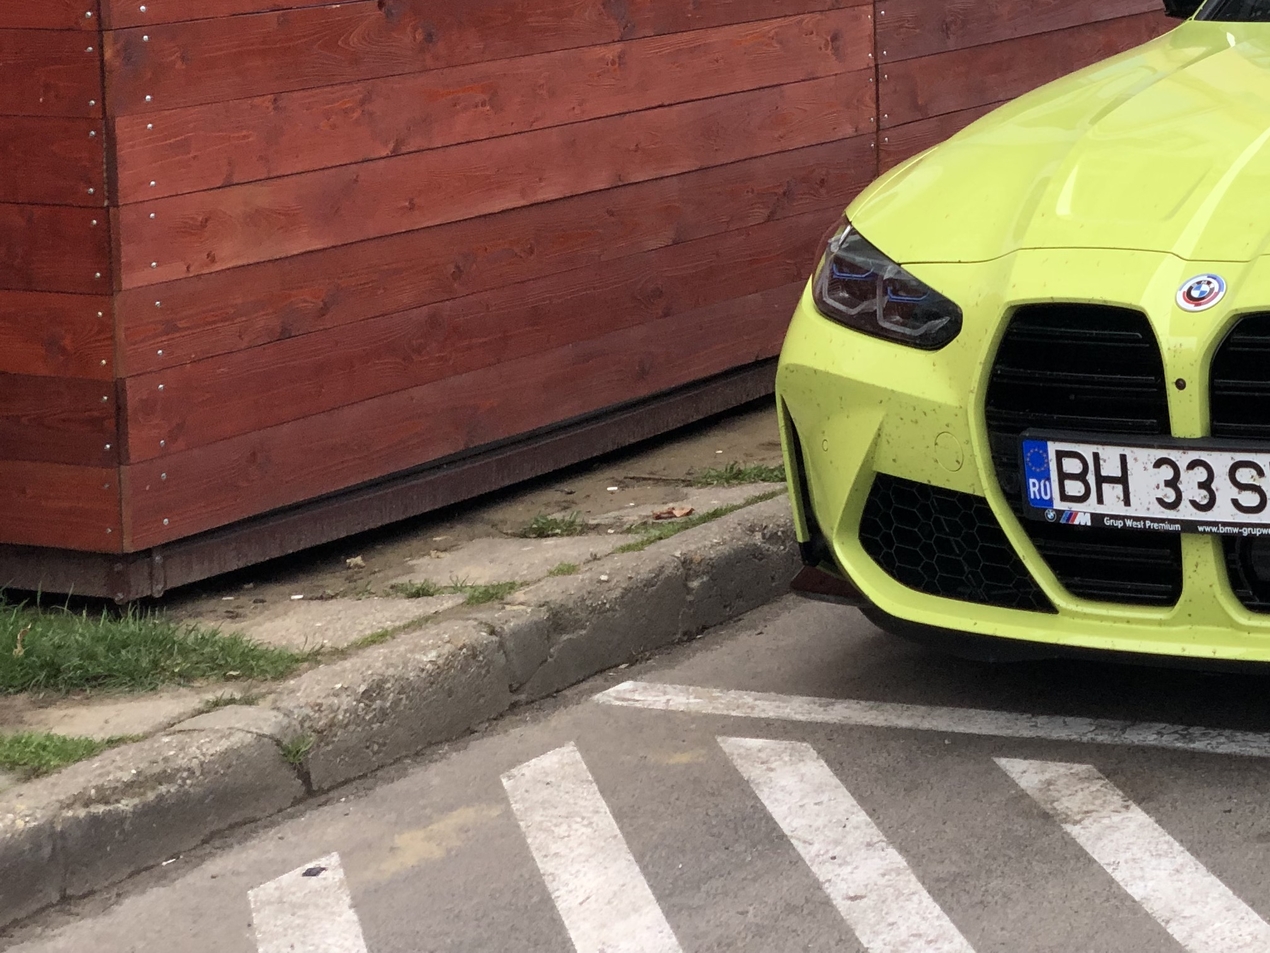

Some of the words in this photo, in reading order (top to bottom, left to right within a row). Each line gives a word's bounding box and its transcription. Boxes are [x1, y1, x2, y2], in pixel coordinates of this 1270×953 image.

[1028, 478, 1050, 501] RO
[1054, 449, 1132, 508] BH
[1152, 456, 1218, 513] 33
[1103, 516, 1124, 529] Grup
[1125, 518, 1144, 529] West
[1145, 519, 1182, 532] Premium
